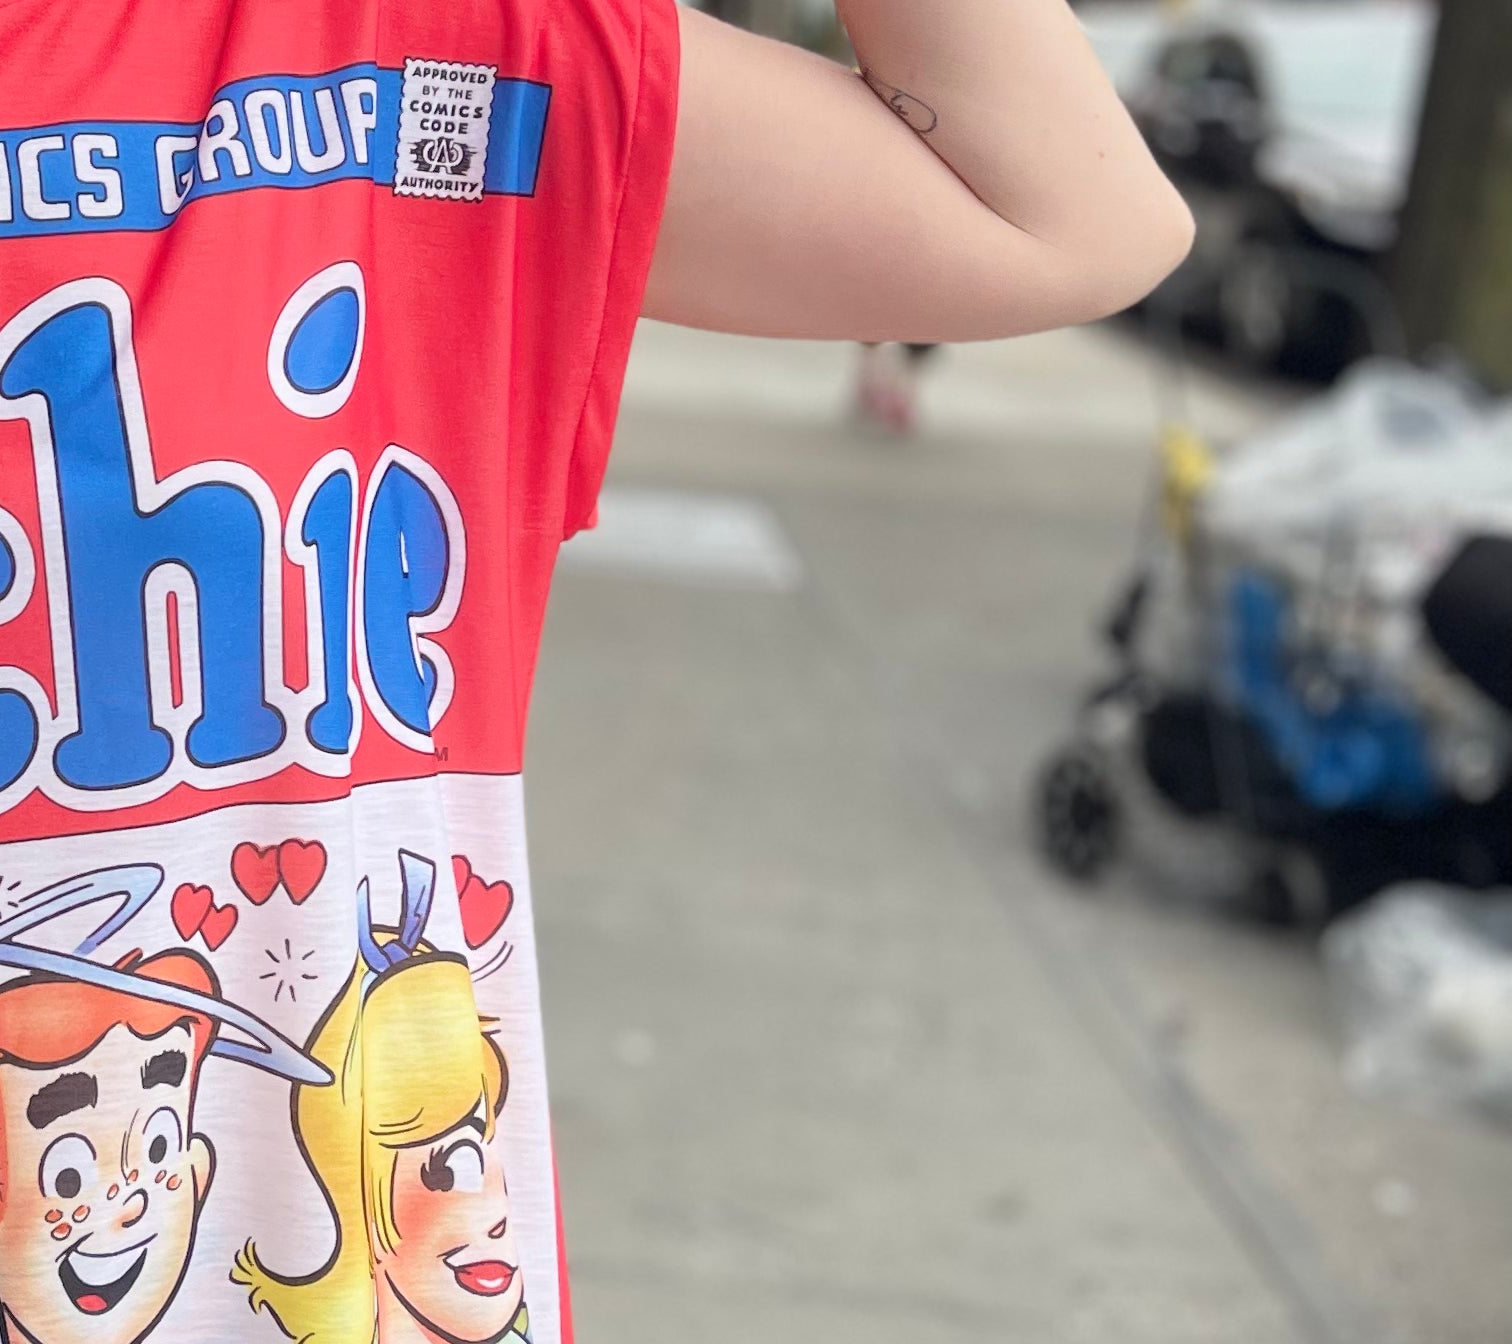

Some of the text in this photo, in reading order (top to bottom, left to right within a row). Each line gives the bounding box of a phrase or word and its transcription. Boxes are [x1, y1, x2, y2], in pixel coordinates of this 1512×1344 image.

[412, 66, 488, 84] APPROVED
[422, 85, 473, 100] BY THE
[409, 100, 484, 118] COMICS
[419, 118, 469, 135] CODE
[154, 77, 378, 216] GROUP
[400, 176, 480, 193] AUTHORITY
